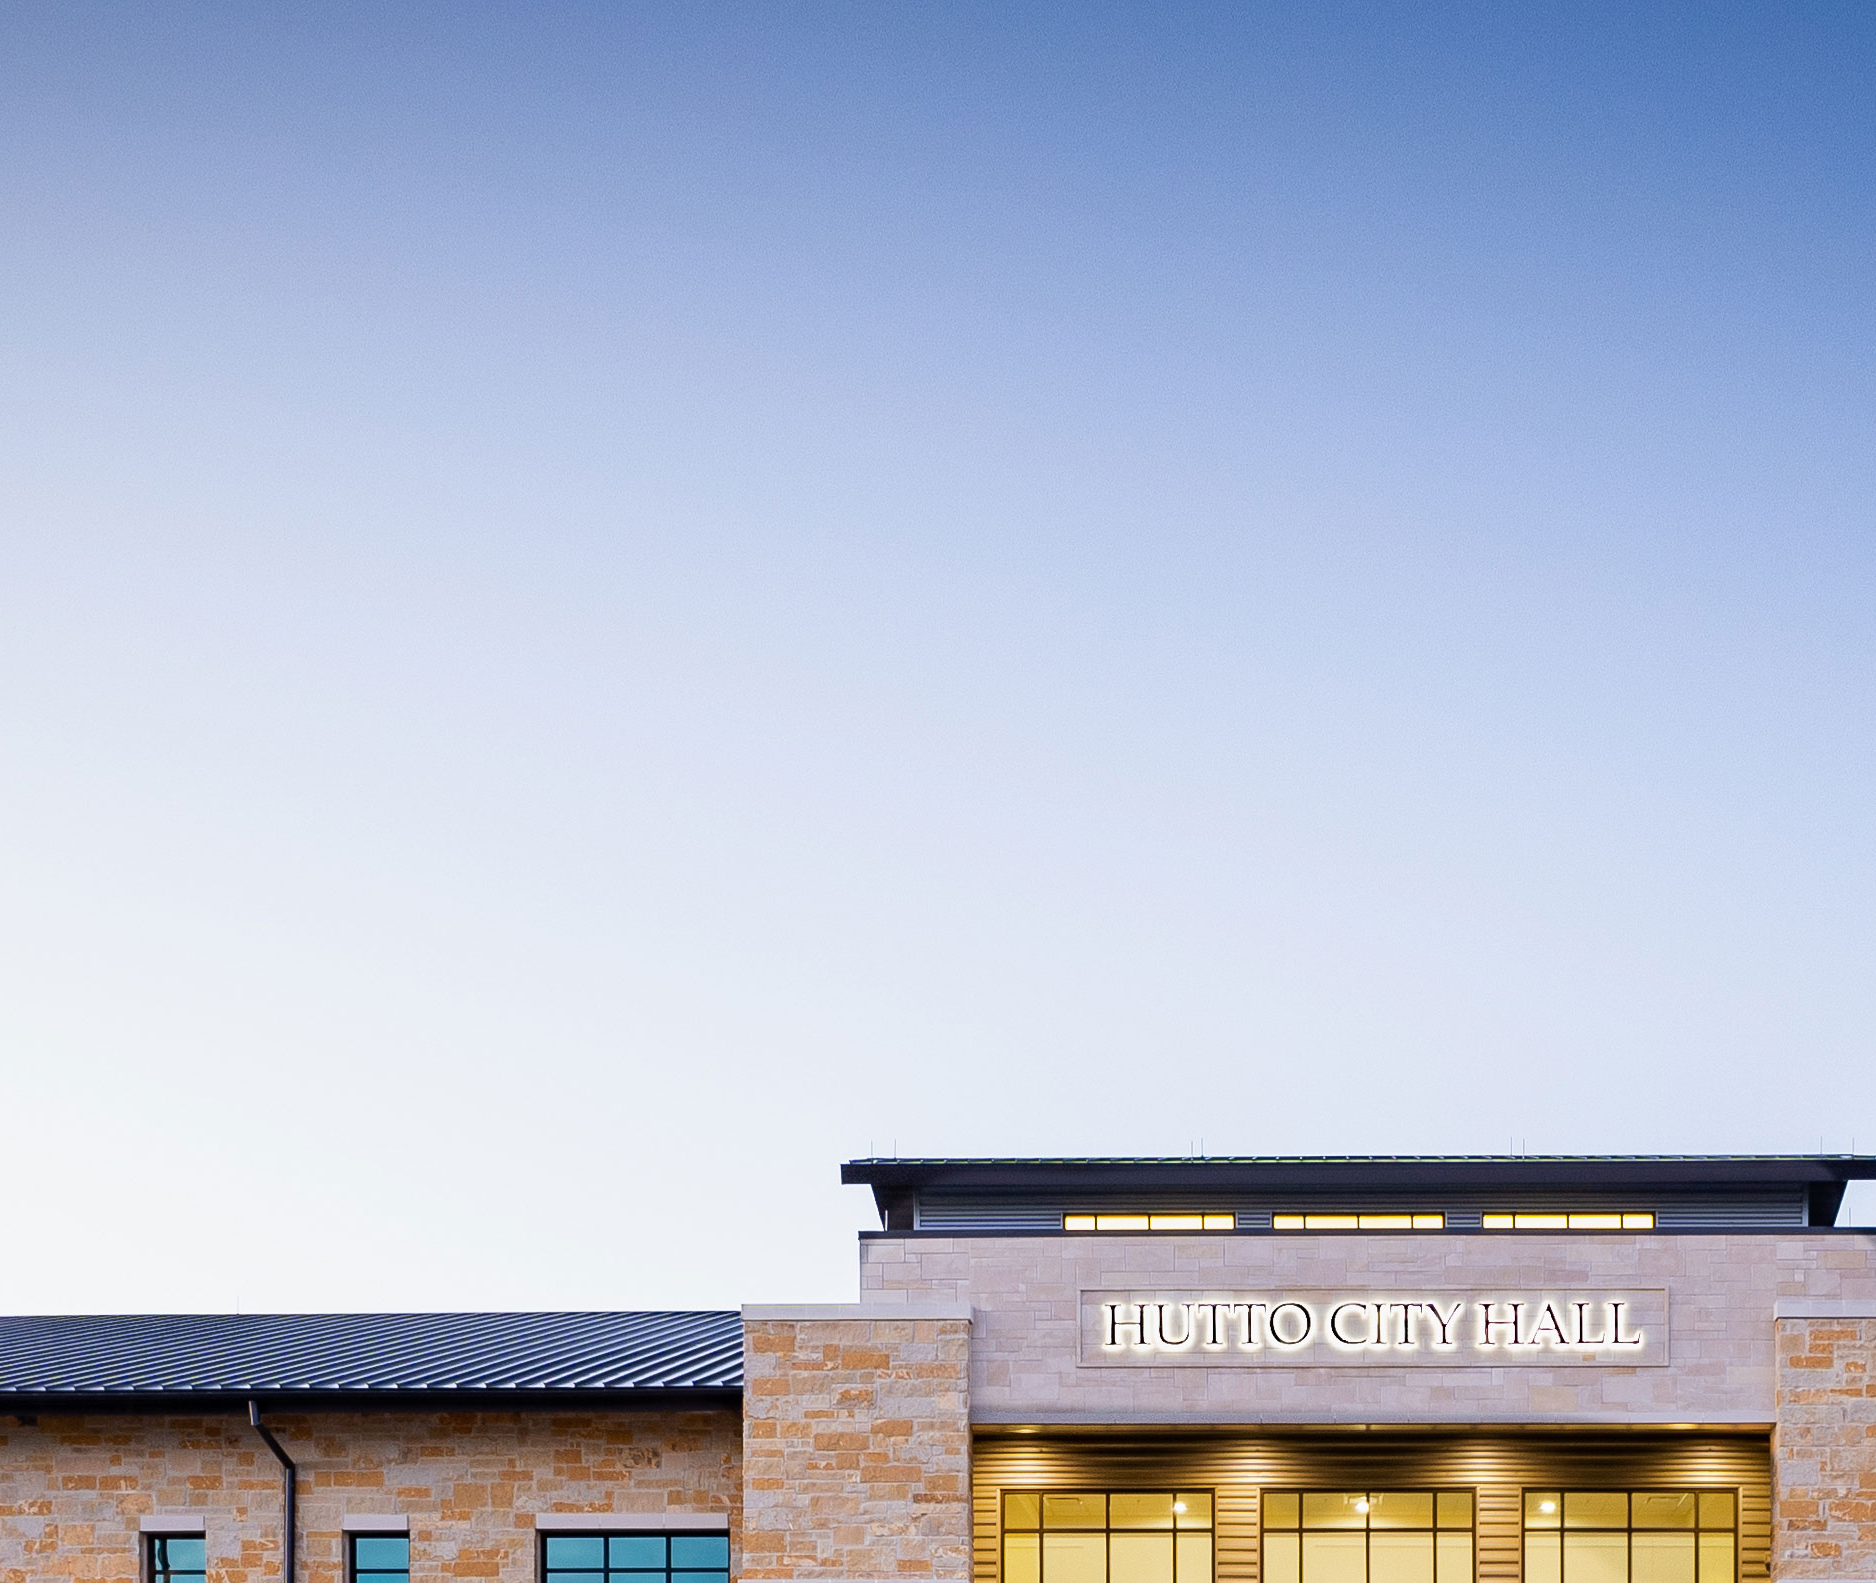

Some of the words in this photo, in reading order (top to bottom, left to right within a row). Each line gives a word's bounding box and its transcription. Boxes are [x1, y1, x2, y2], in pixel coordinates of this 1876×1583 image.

[1105, 1302, 1313, 1346] HUTTO
[1329, 1302, 1462, 1346] CITY
[1478, 1302, 1643, 1346] HALL
